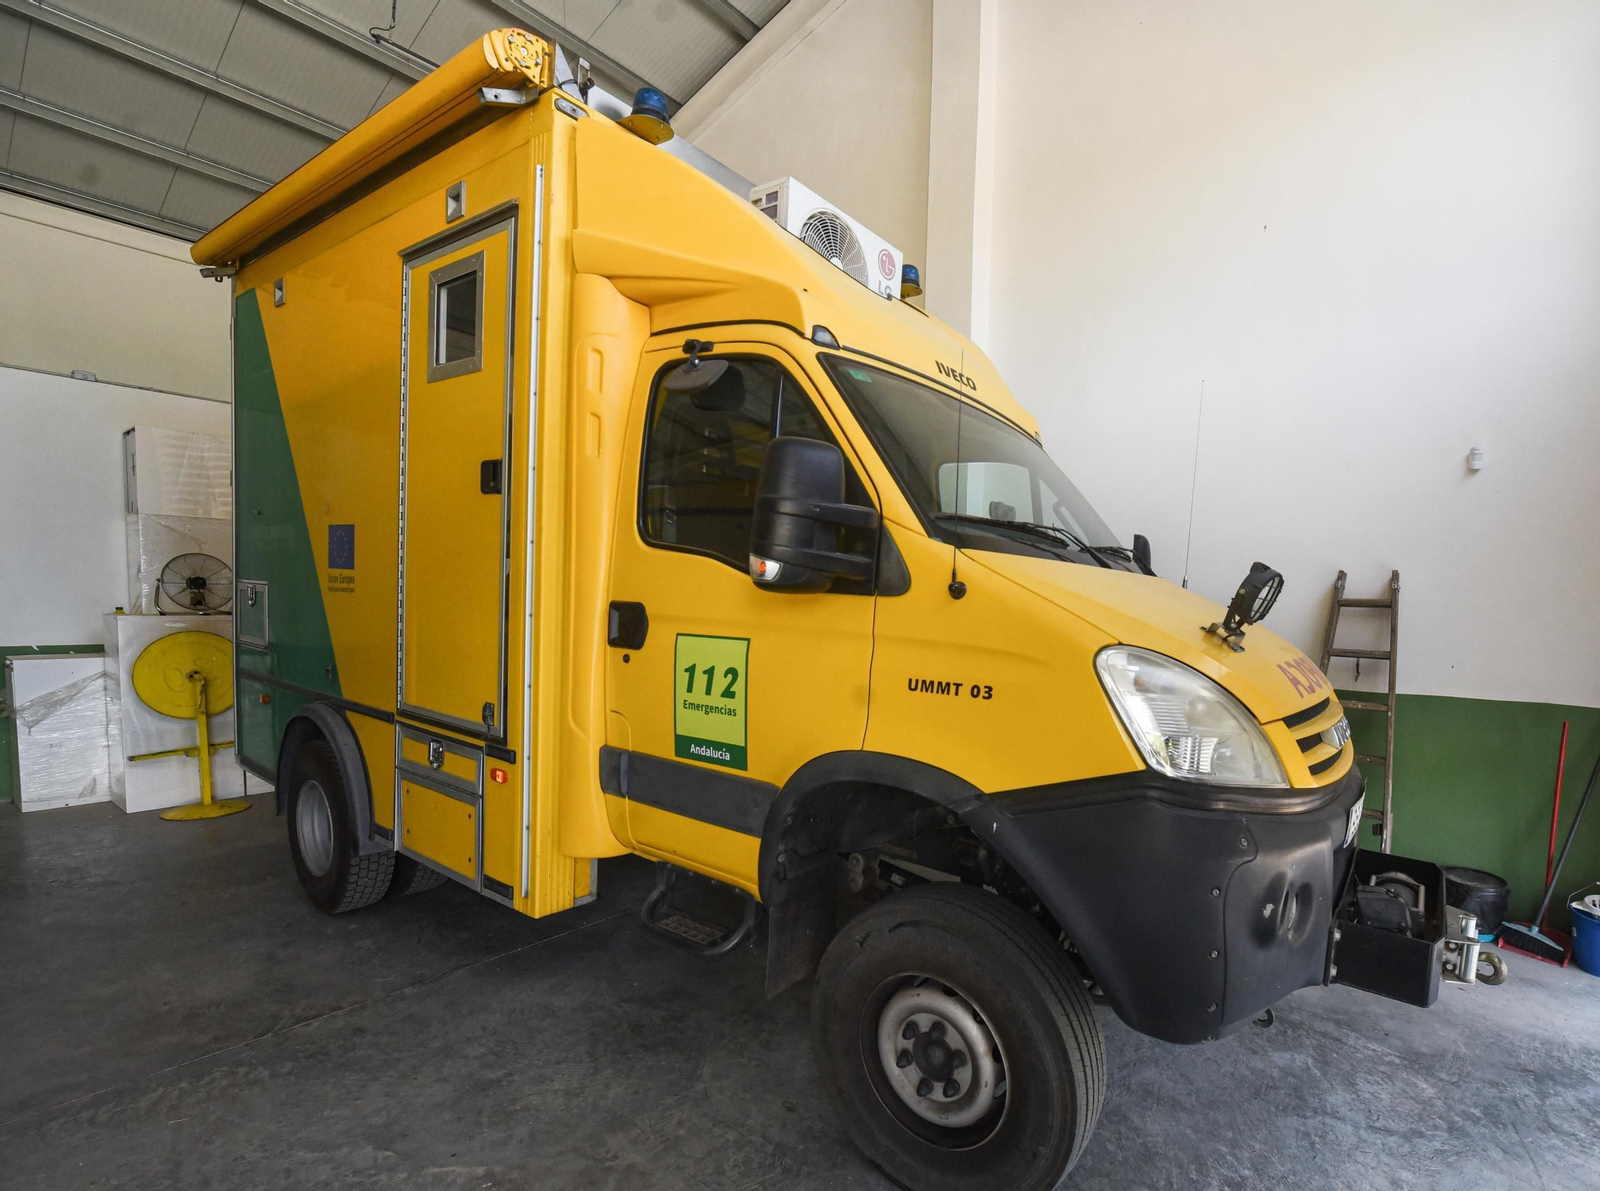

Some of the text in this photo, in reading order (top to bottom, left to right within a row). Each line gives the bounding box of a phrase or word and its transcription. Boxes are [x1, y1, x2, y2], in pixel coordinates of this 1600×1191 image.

[935, 360, 977, 391] IVECO
[684, 663, 739, 699] 112
[908, 678, 993, 700] UMMT 03
[683, 700, 737, 717] Emergencias
[690, 744, 730, 760] Andalucía
